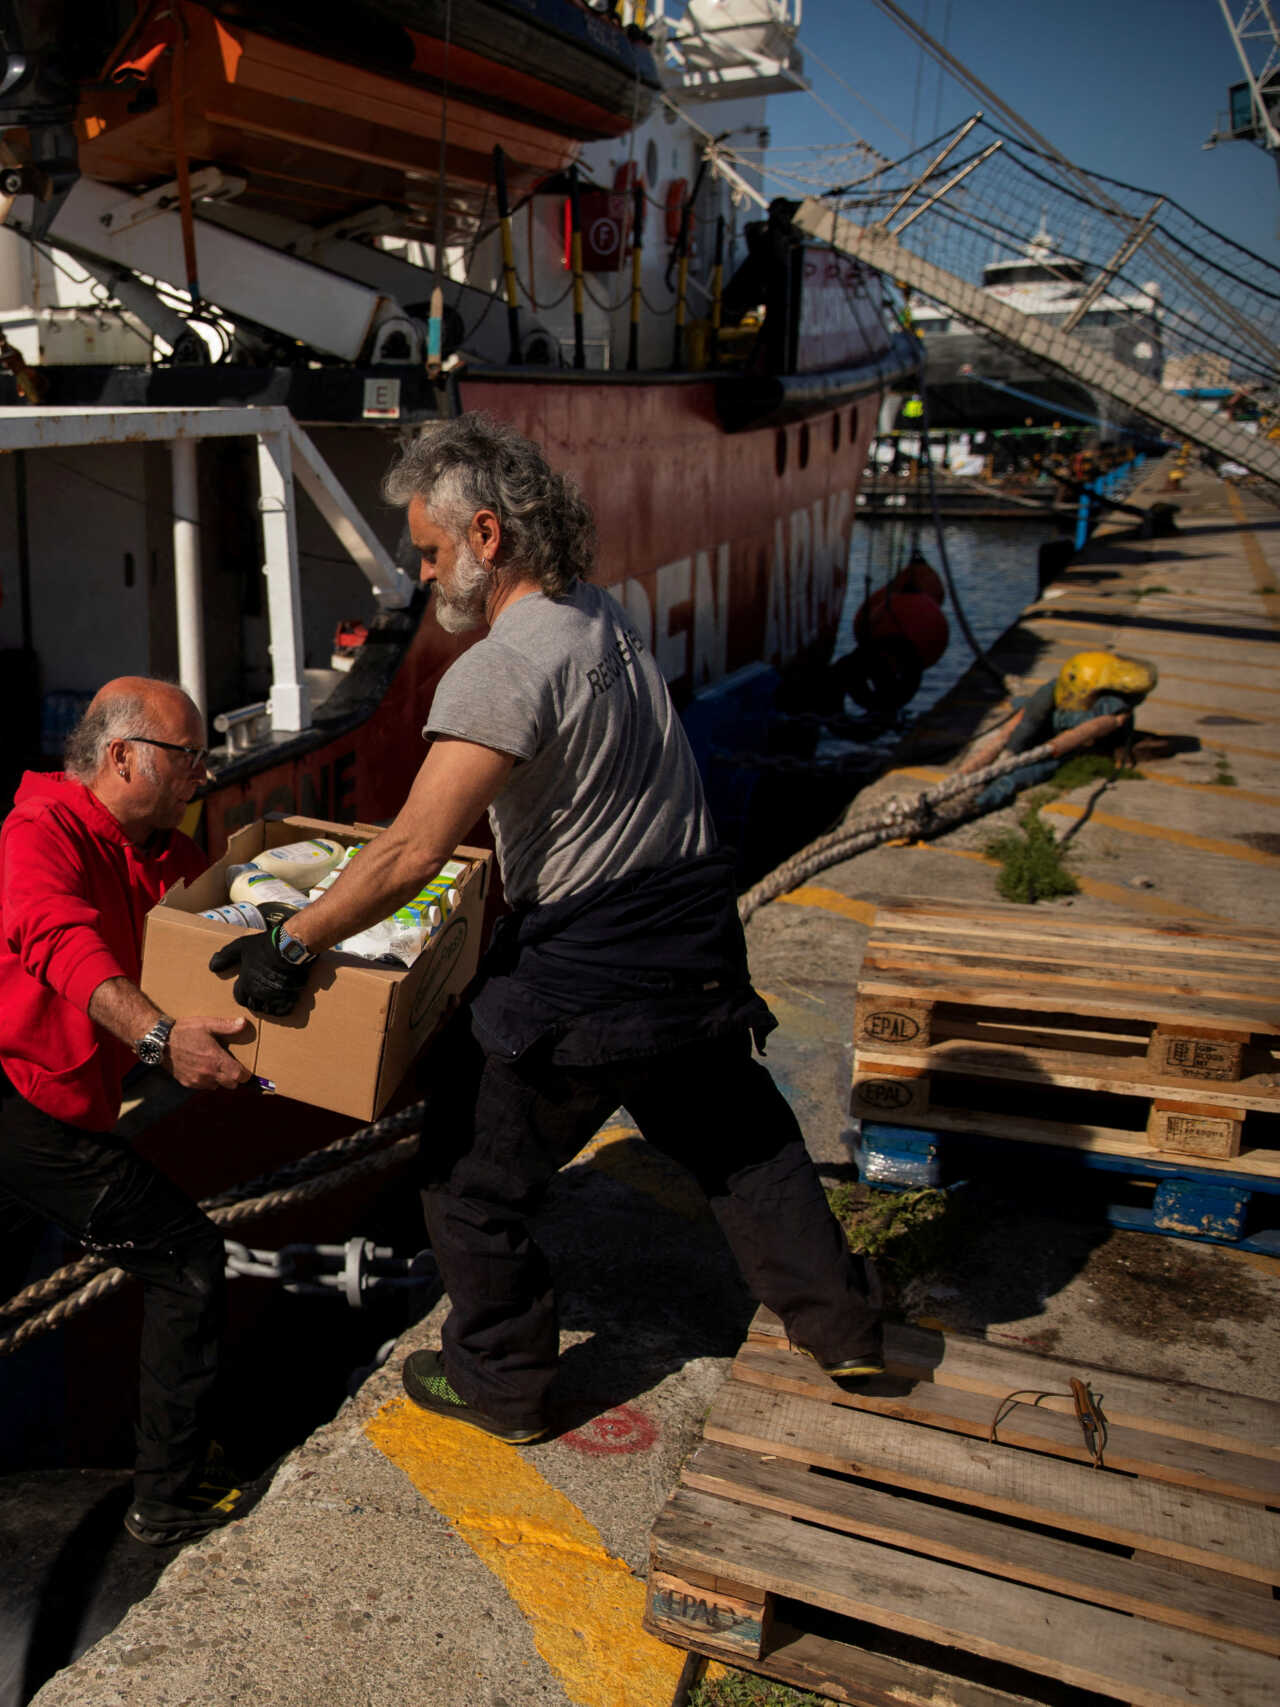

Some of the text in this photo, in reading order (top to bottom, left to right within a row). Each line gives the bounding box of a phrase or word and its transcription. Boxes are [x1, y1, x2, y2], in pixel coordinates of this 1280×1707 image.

[375, 386, 388, 405] E
[871, 1015, 909, 1038] EPAL
[864, 1084, 902, 1104] EPAL
